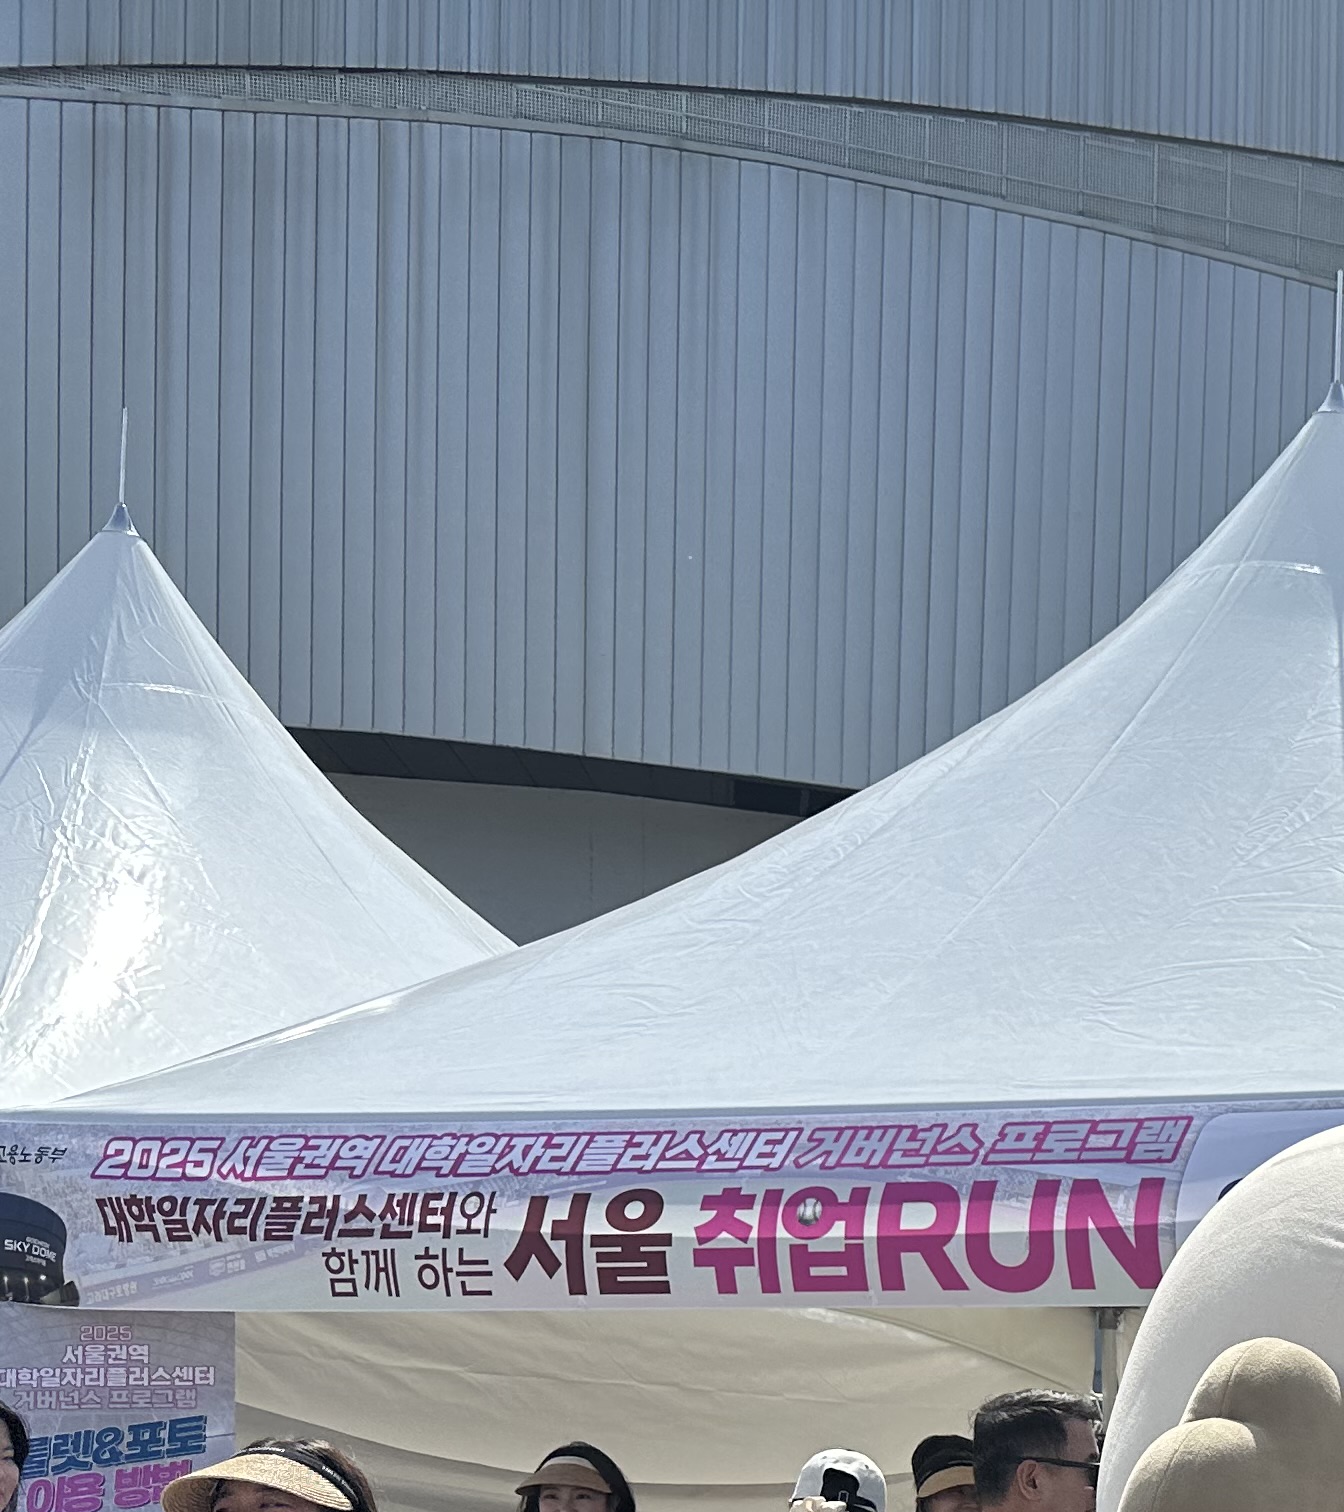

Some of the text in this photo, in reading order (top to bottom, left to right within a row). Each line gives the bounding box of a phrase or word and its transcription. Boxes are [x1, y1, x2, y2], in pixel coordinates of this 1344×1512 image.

[90, 1116, 1193, 1182] 2025 서울권역 대학일자리플러스센터 거버넌스 프로그램
[96, 1189, 498, 1244] 대학일자리플러스센터와
[4, 1239, 30, 1253] SKY
[503, 1177, 1166, 1295] 서울 취업RUN
[321, 1246, 493, 1297] 함께 하는
[80, 1325, 132, 1341] 2025
[62, 1345, 150, 1365] 서울권역
[0, 1366, 216, 1388] 대학일자리플러스센터
[14, 1388, 198, 1410] 거버넌스 프로그램
